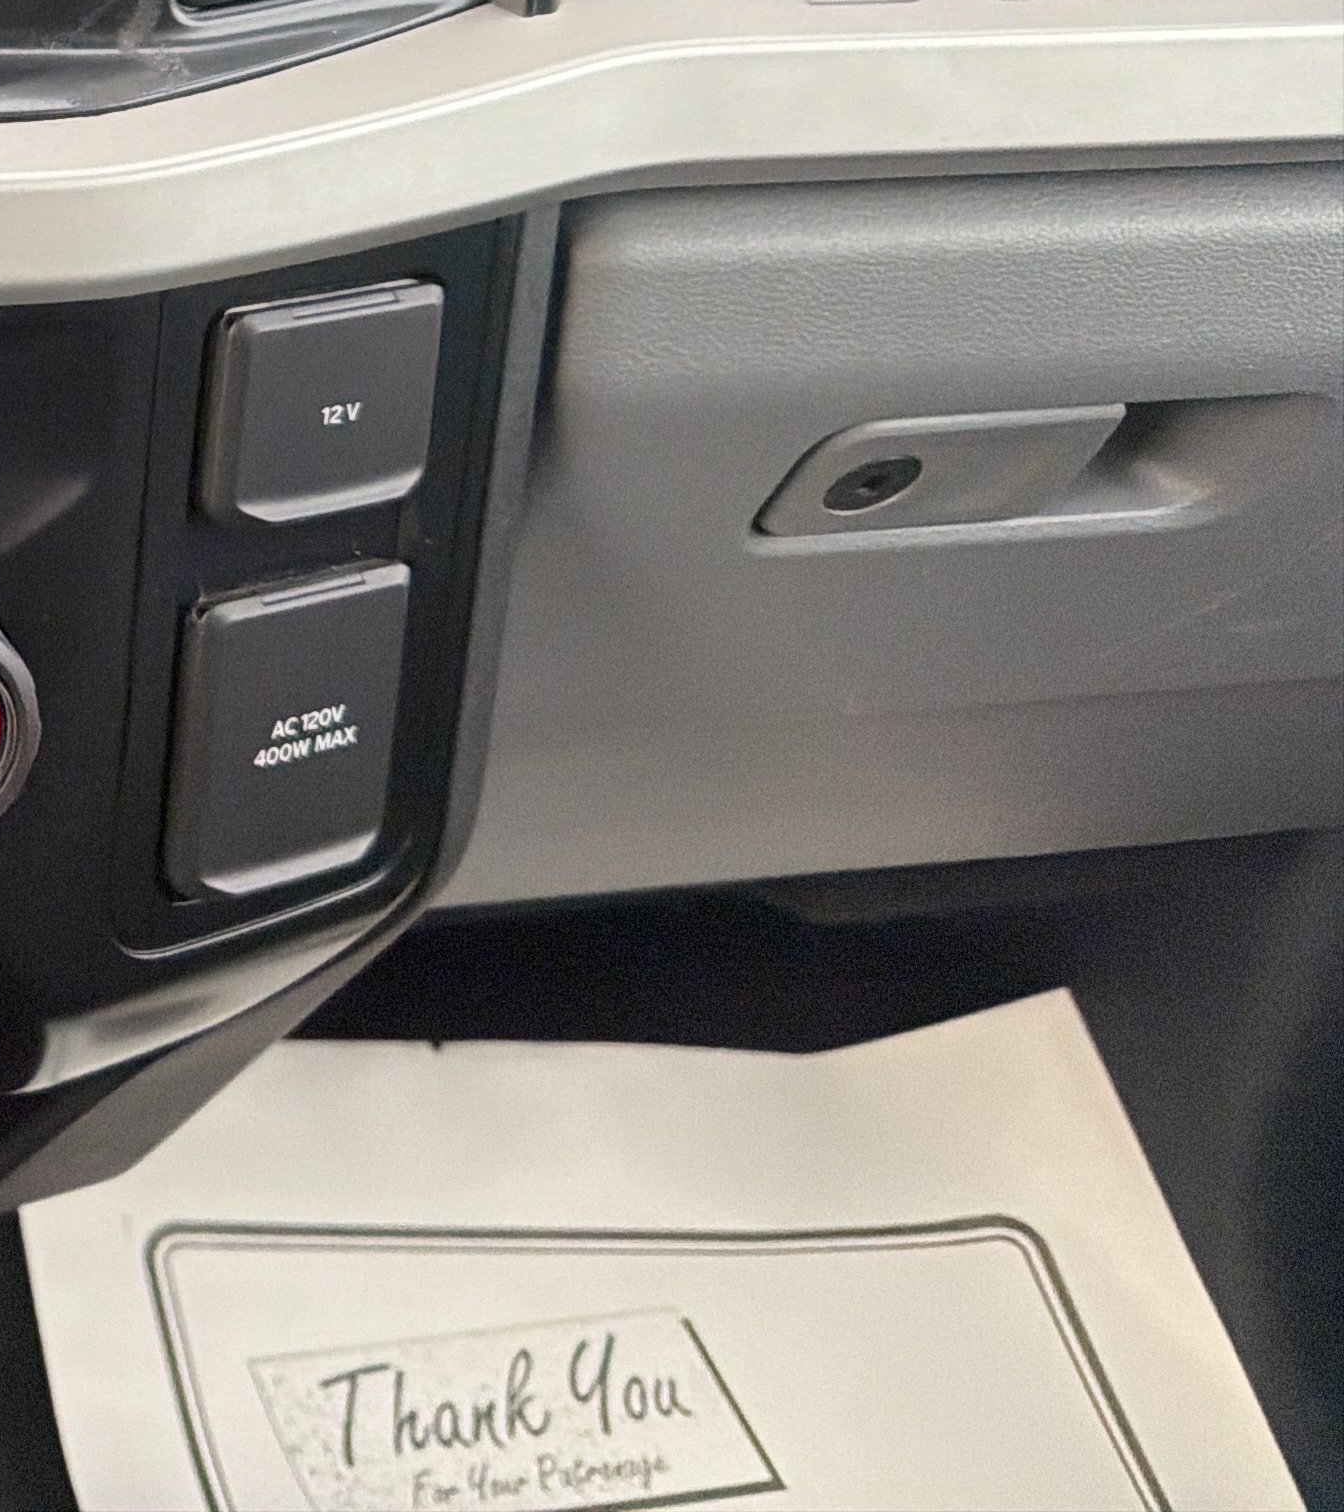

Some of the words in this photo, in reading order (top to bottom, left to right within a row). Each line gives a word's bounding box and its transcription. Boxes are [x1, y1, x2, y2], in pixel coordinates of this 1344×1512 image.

[271, 716, 300, 740] AC
[301, 704, 346, 731] 120V
[253, 738, 312, 767] 400W
[314, 725, 359, 753] MAX
[319, 1349, 551, 1468] Thank
[569, 1332, 693, 1435] You
[413, 1469, 458, 1509] For
